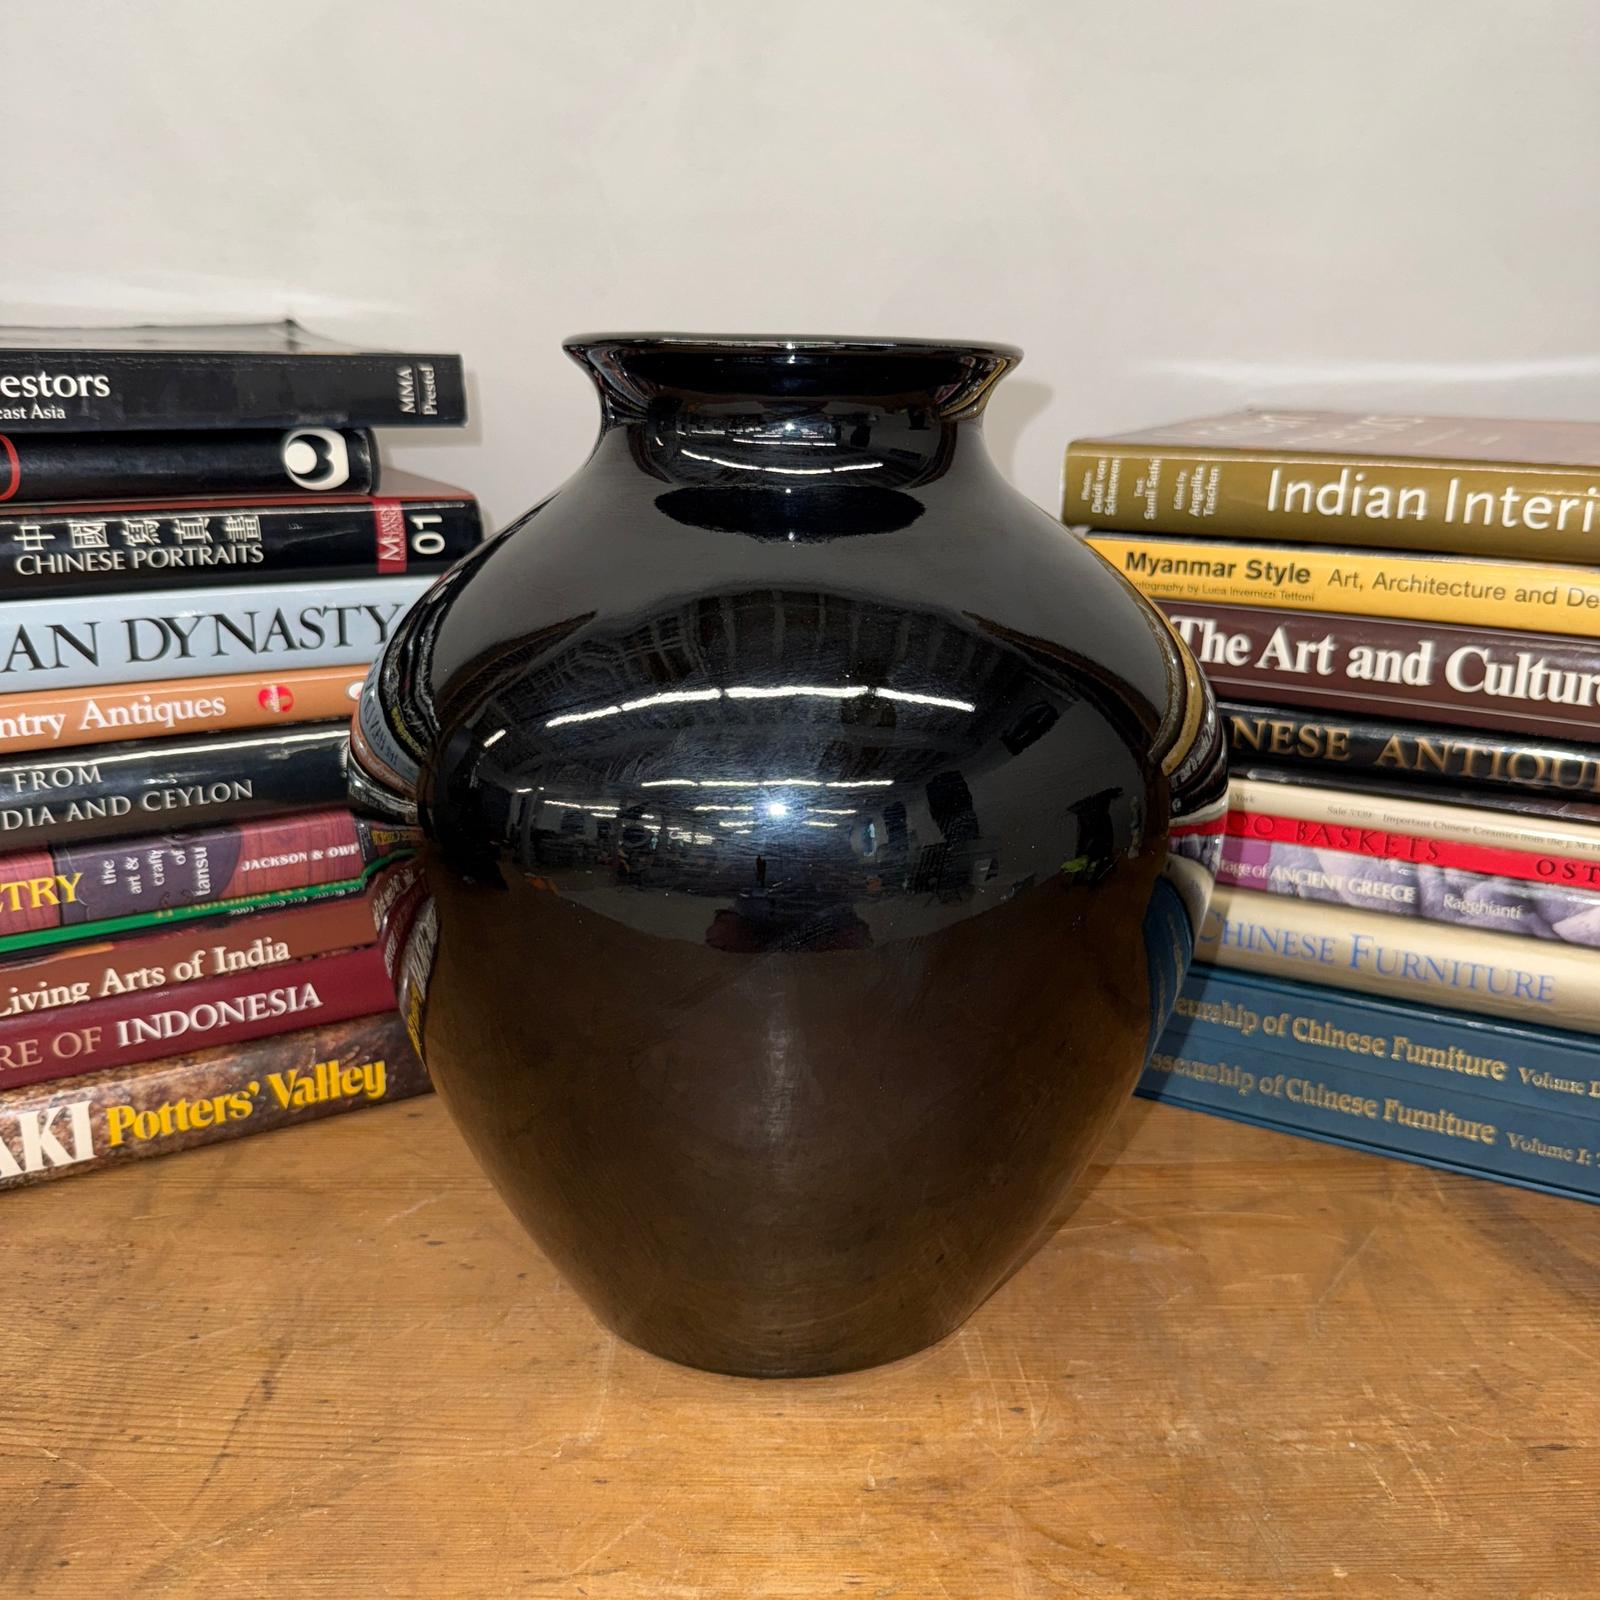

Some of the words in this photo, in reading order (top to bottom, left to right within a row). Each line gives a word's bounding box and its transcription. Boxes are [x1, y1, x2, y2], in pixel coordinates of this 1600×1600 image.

[0, 370, 111, 398] estors
[397, 365, 417, 414] MMA
[417, 362, 438, 416] Prestel
[30, 402, 67, 419] Asia
[1143, 489, 1158, 520] Sunil
[1189, 464, 1206, 517] Angelika
[1203, 466, 1220, 517] Taschen
[1266, 468, 1428, 521] Indian
[410, 514, 446, 555] 01
[15, 550, 127, 576] CHINESE
[132, 543, 265, 569] PORTRAITS
[1125, 551, 1237, 578] Myanmar
[1245, 559, 1312, 587] Style
[1327, 568, 1364, 593] Art,
[1372, 571, 1506, 601] Architecture
[1514, 586, 1558, 605] and
[1566, 587, 1600, 609] De
[1187, 582, 1199, 595] by
[1202, 583, 1227, 595] Luca
[0, 620, 100, 672] AN
[120, 603, 405, 663] DYNASTY
[1170, 614, 1252, 667] The
[1254, 624, 1337, 676] Art
[1345, 638, 1437, 687] and
[0, 712, 67, 740] ntry
[79, 694, 227, 732] Antiques
[1230, 714, 1352, 763] NESE
[1374, 734, 1600, 792] ANTIQU
[13, 765, 104, 793] FROM
[0, 804, 57, 831] DIA
[66, 795, 132, 823] AND
[141, 779, 253, 812] CEYLON
[126, 856, 140, 871] &
[171, 848, 187, 866] of
[240, 852, 307, 872] JACKSON
[310, 849, 324, 861] &
[1296, 819, 1441, 863] BASKETS
[0, 872, 84, 914] TRY
[102, 859, 117, 886] the
[127, 873, 142, 895] art
[194, 847, 212, 896] tansu
[1252, 863, 1271, 878] of
[1270, 865, 1345, 891] ANCIENT
[1348, 877, 1417, 905] GREECE
[1535, 858, 1600, 884] OST
[1443, 893, 1521, 921] Ragghianti
[100, 967, 167, 998] Arts
[174, 950, 207, 982] of
[213, 936, 291, 976] India
[1349, 932, 1557, 1004] FURNITURE
[52, 1027, 103, 1060] OF
[116, 982, 323, 1048] INDONESIA
[1262, 1012, 1290, 1037] of
[1291, 1016, 1386, 1057] Chinese
[1391, 1035, 1508, 1081] Furniture
[1517, 1066, 1585, 1096] Volume
[106, 1080, 261, 1148] Potters'
[266, 1059, 388, 1111] Valley
[1258, 1074, 1285, 1098] of
[1285, 1077, 1378, 1120] Chinese
[1382, 1096, 1498, 1145] Furniture
[1505, 1131, 1574, 1162] Volume
